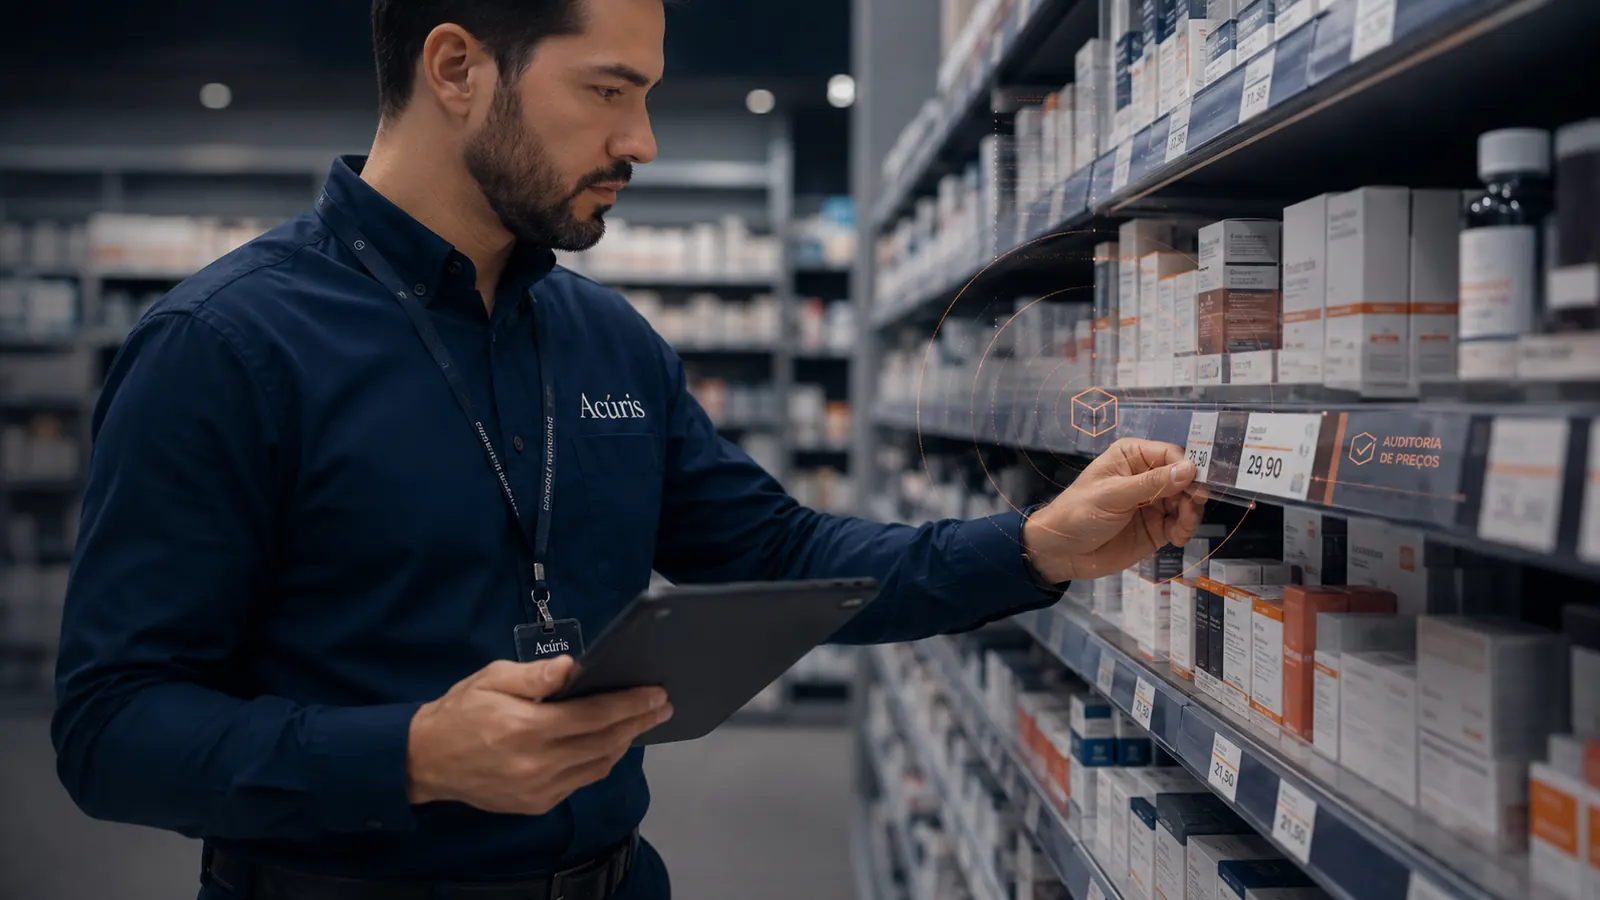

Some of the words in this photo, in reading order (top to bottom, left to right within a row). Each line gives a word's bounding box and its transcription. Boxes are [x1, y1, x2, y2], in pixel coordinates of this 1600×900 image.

[580, 391, 646, 419] Acúris
[1382, 435, 1442, 449] AUDITORIA
[1246, 454, 1283, 479] 29,90
[1379, 451, 1394, 464] DE
[1395, 452, 1440, 470] PREÇOS
[534, 638, 569, 656] Acúris
[1214, 761, 1234, 787] 21,50
